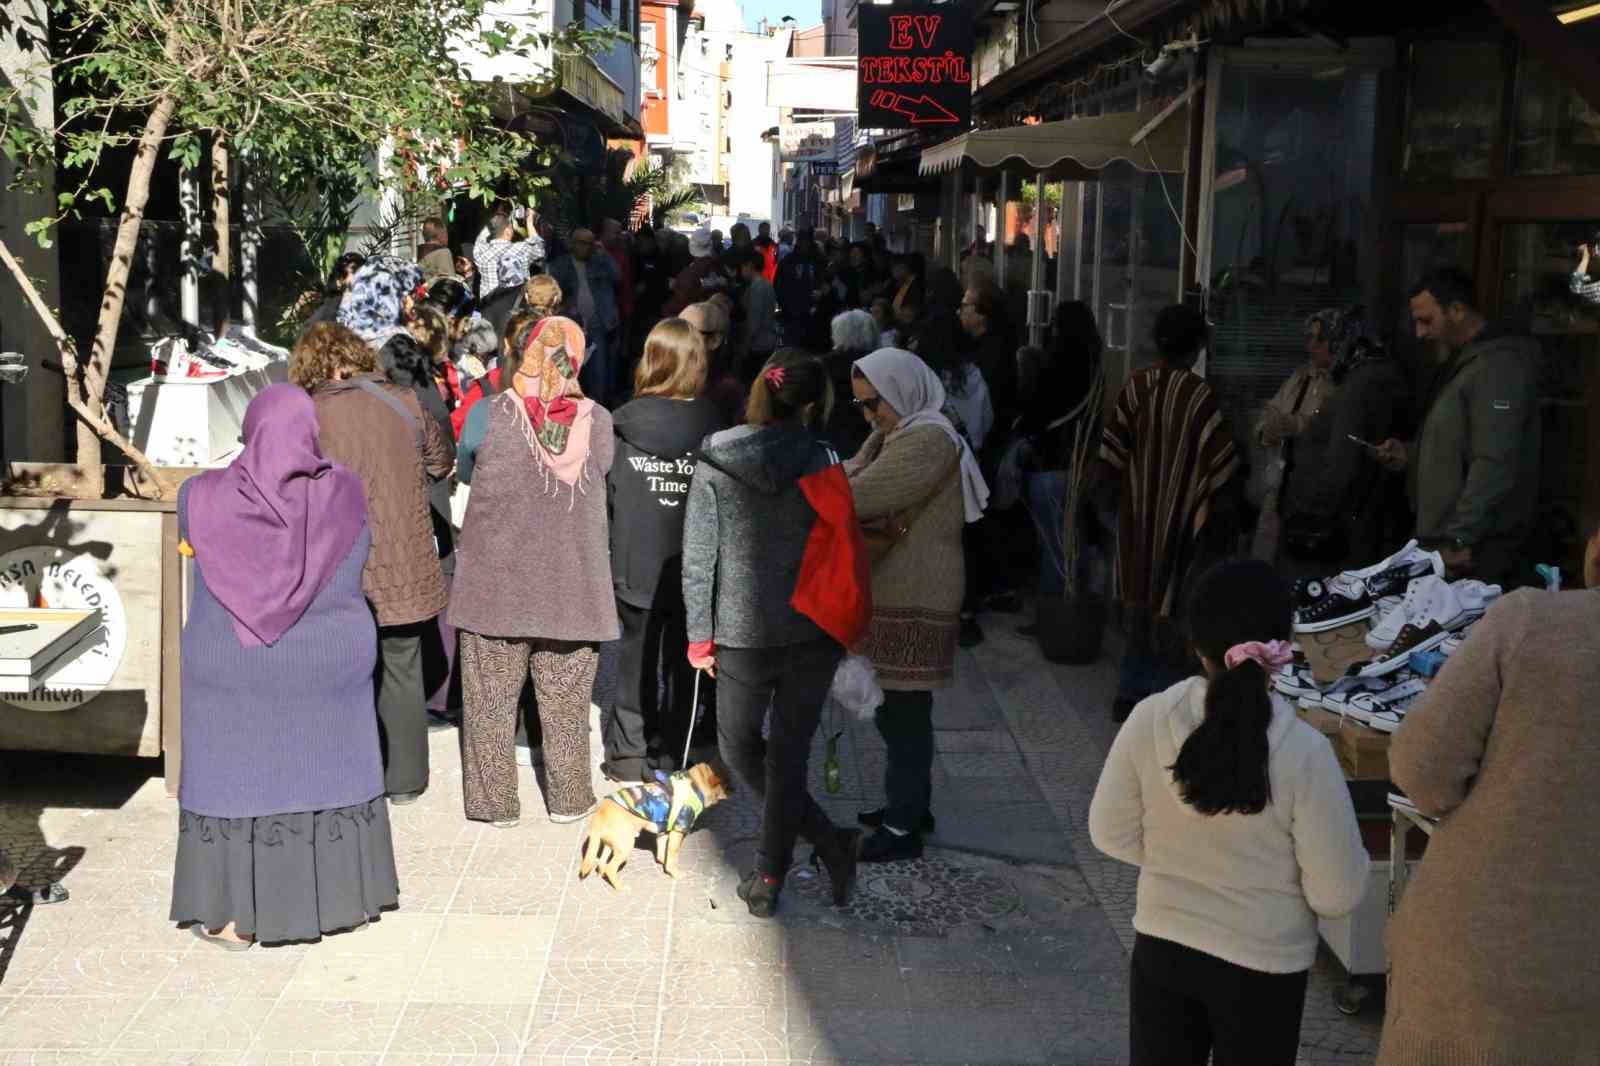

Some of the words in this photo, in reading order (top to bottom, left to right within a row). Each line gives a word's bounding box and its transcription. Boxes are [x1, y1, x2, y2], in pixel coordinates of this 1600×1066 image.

[888, 15, 942, 50] EV
[861, 50, 971, 83] TEKSTİL
[628, 456, 674, 473] Waste
[675, 459, 697, 475] Yo
[646, 476, 689, 493] Time
